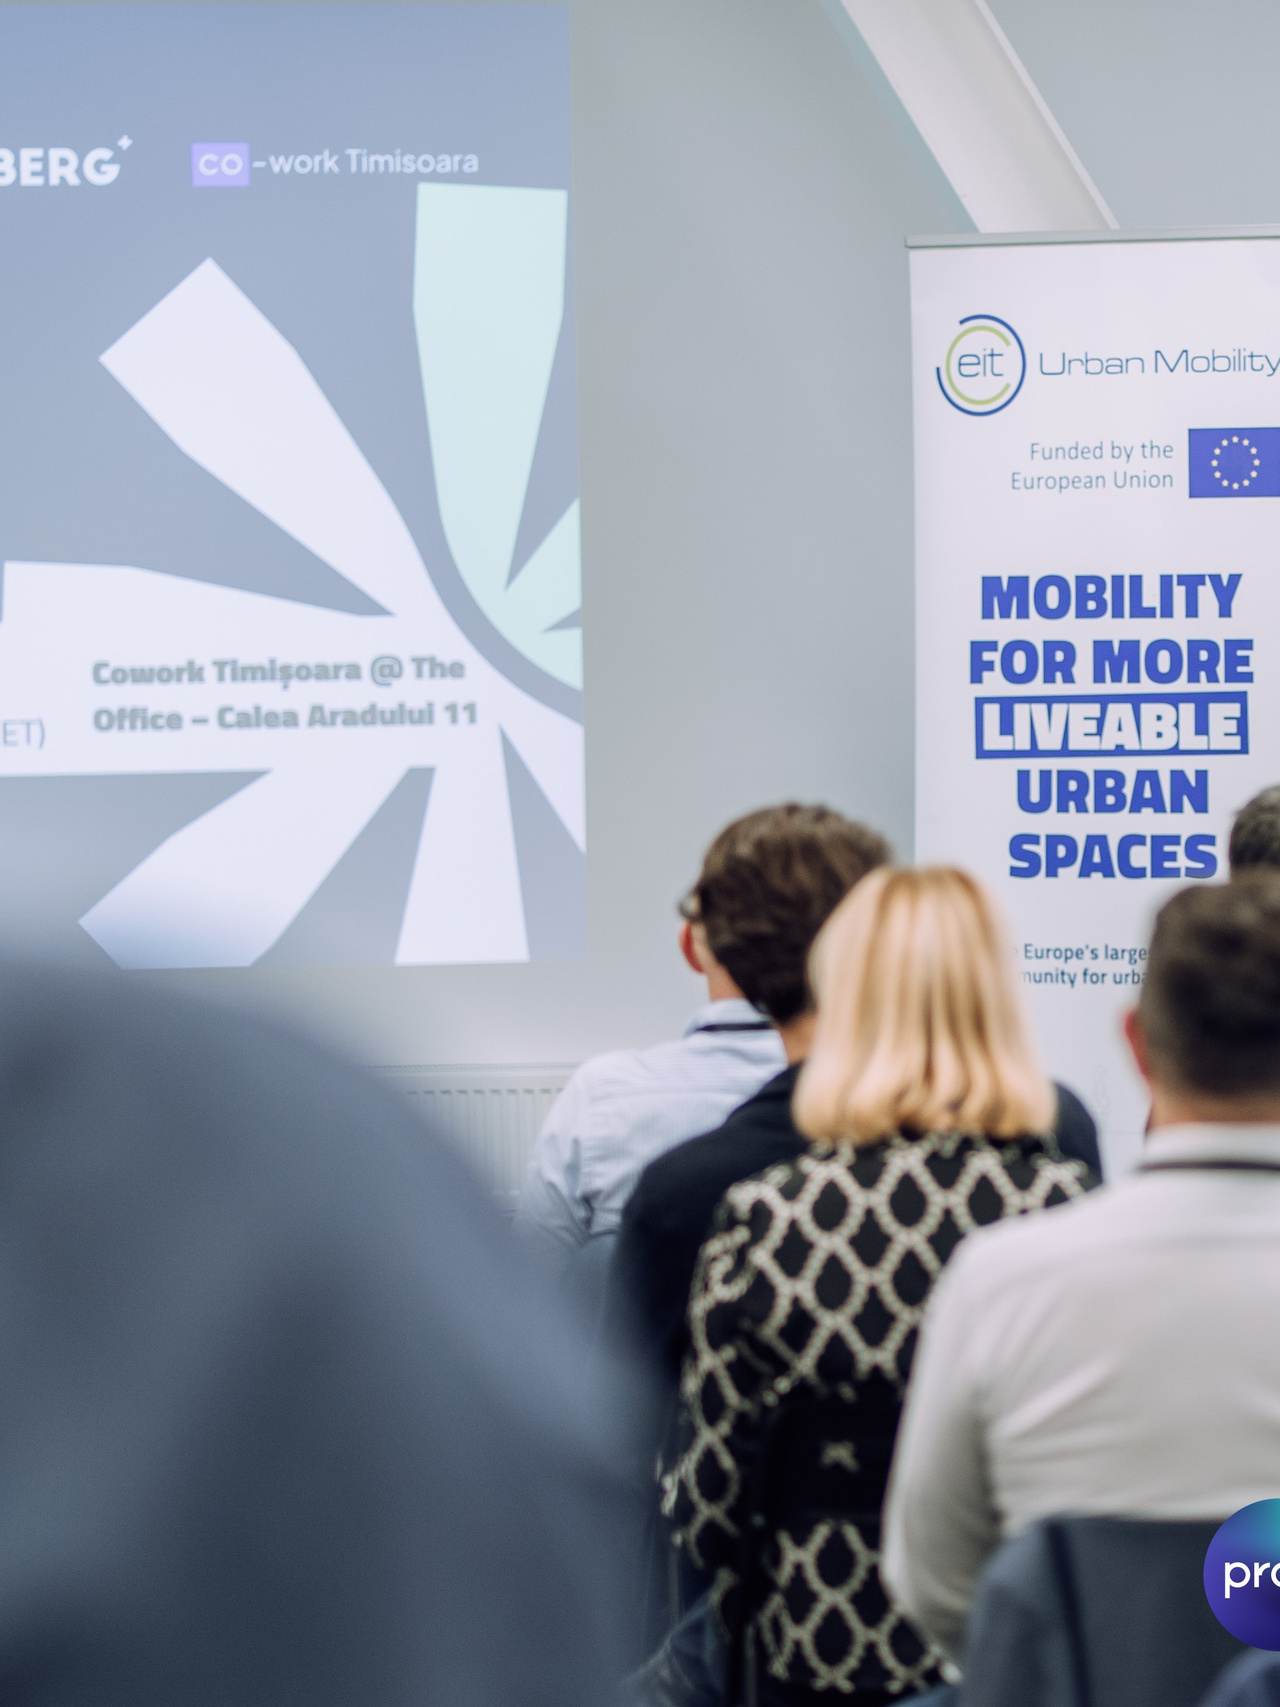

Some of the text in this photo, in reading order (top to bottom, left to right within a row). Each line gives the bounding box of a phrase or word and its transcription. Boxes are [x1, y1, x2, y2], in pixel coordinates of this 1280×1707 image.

[344, 149, 479, 175] Timisoara
[957, 348, 1004, 378] eit
[1039, 351, 1145, 376] Urban
[1030, 440, 1174, 463] Funded by the
[1011, 470, 1173, 493] European Union
[981, 573, 1243, 620] MOBILITY
[92, 659, 205, 686] Cowork
[370, 655, 403, 687] @
[410, 656, 465, 679] The
[970, 639, 1254, 684] FOR MORE
[93, 707, 184, 732] Office
[216, 705, 300, 730] Calea
[307, 702, 435, 728] Aradului
[443, 702, 478, 725] 11
[982, 702, 1242, 752] LIVEABLE
[1016, 769, 1210, 814] URBAN
[1008, 834, 1218, 879] SPACES
[1023, 943, 1099, 965] Europe's
[1082, 967, 1107, 985] for
